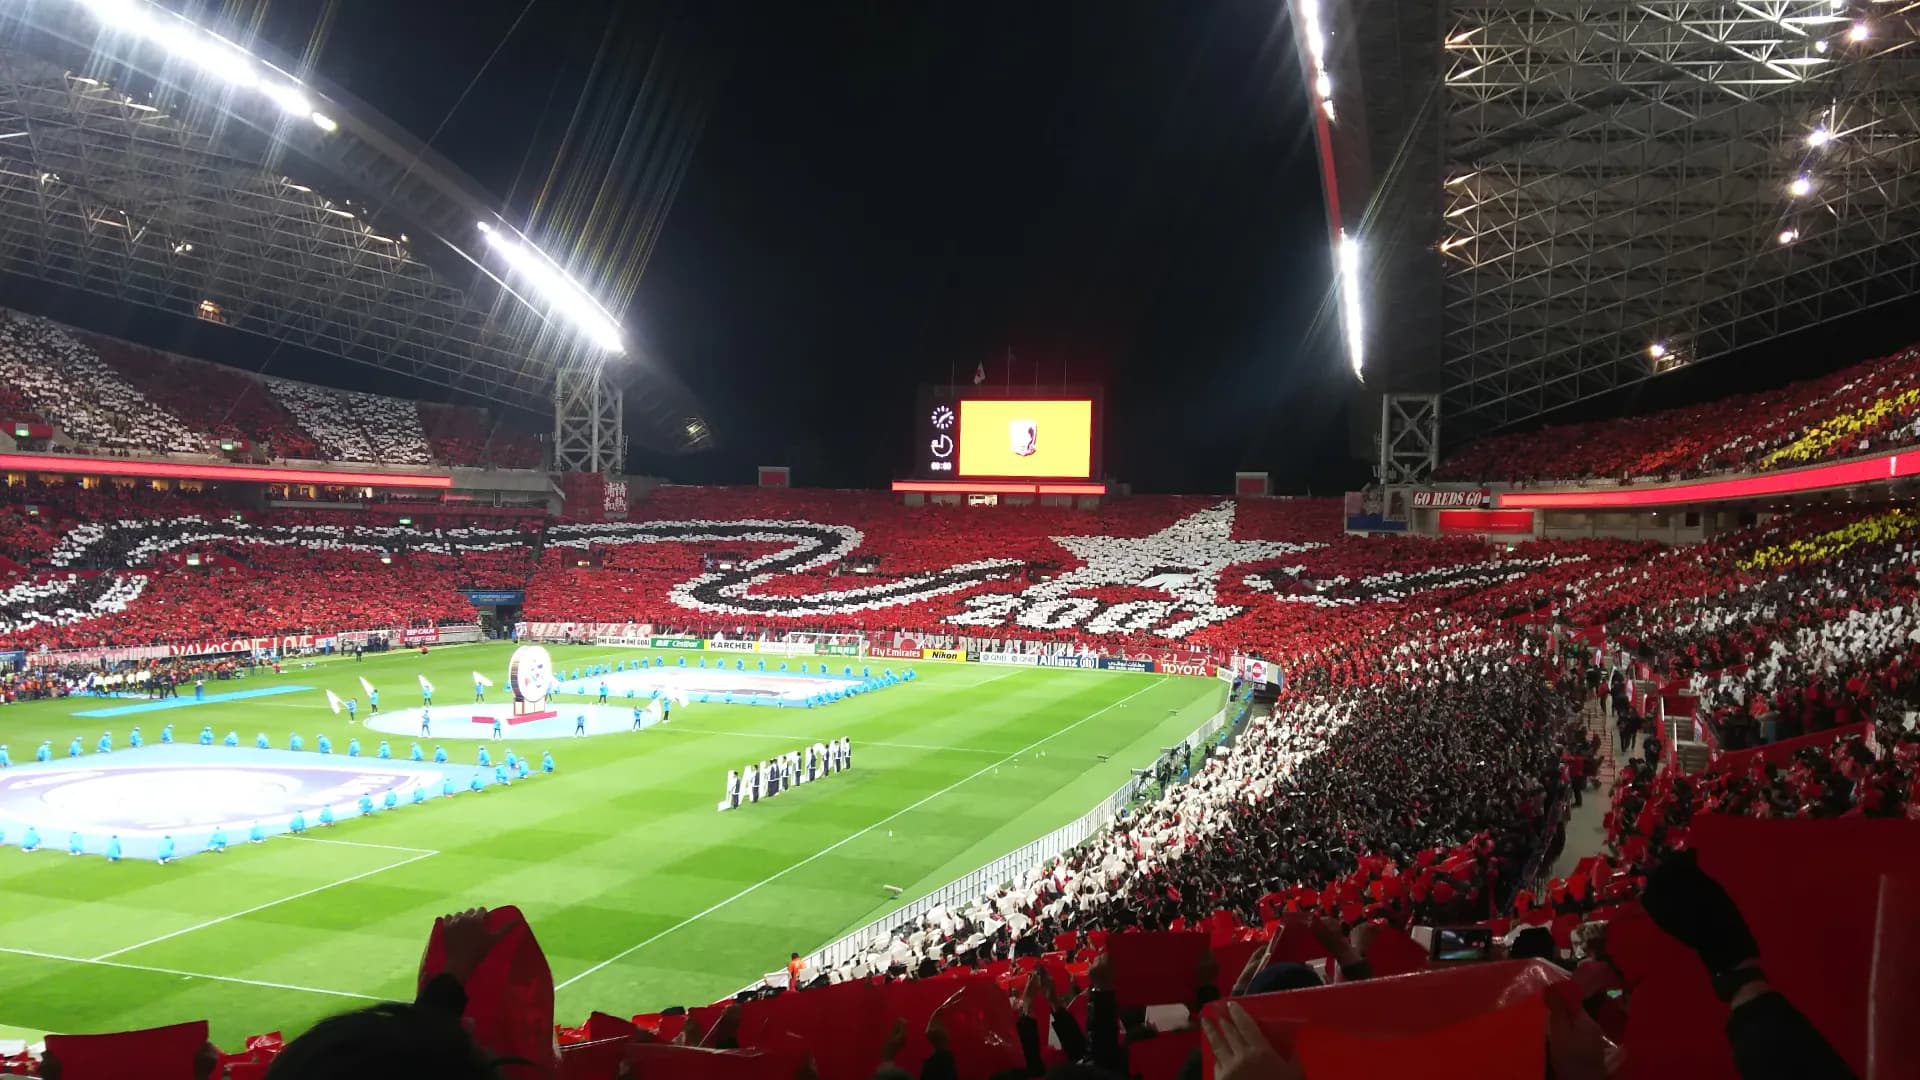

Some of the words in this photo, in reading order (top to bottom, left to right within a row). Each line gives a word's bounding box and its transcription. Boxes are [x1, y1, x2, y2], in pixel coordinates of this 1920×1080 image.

[1414, 491, 1431, 505] GO
[1432, 491, 1464, 505] REDS
[1465, 491, 1482, 505] GO
[872, 647, 885, 657] Fly
[886, 648, 921, 658] Emirates
[932, 651, 958, 660] Nikon
[1039, 655, 1078, 667] Allianz
[1161, 663, 1207, 676] TOYOTA
